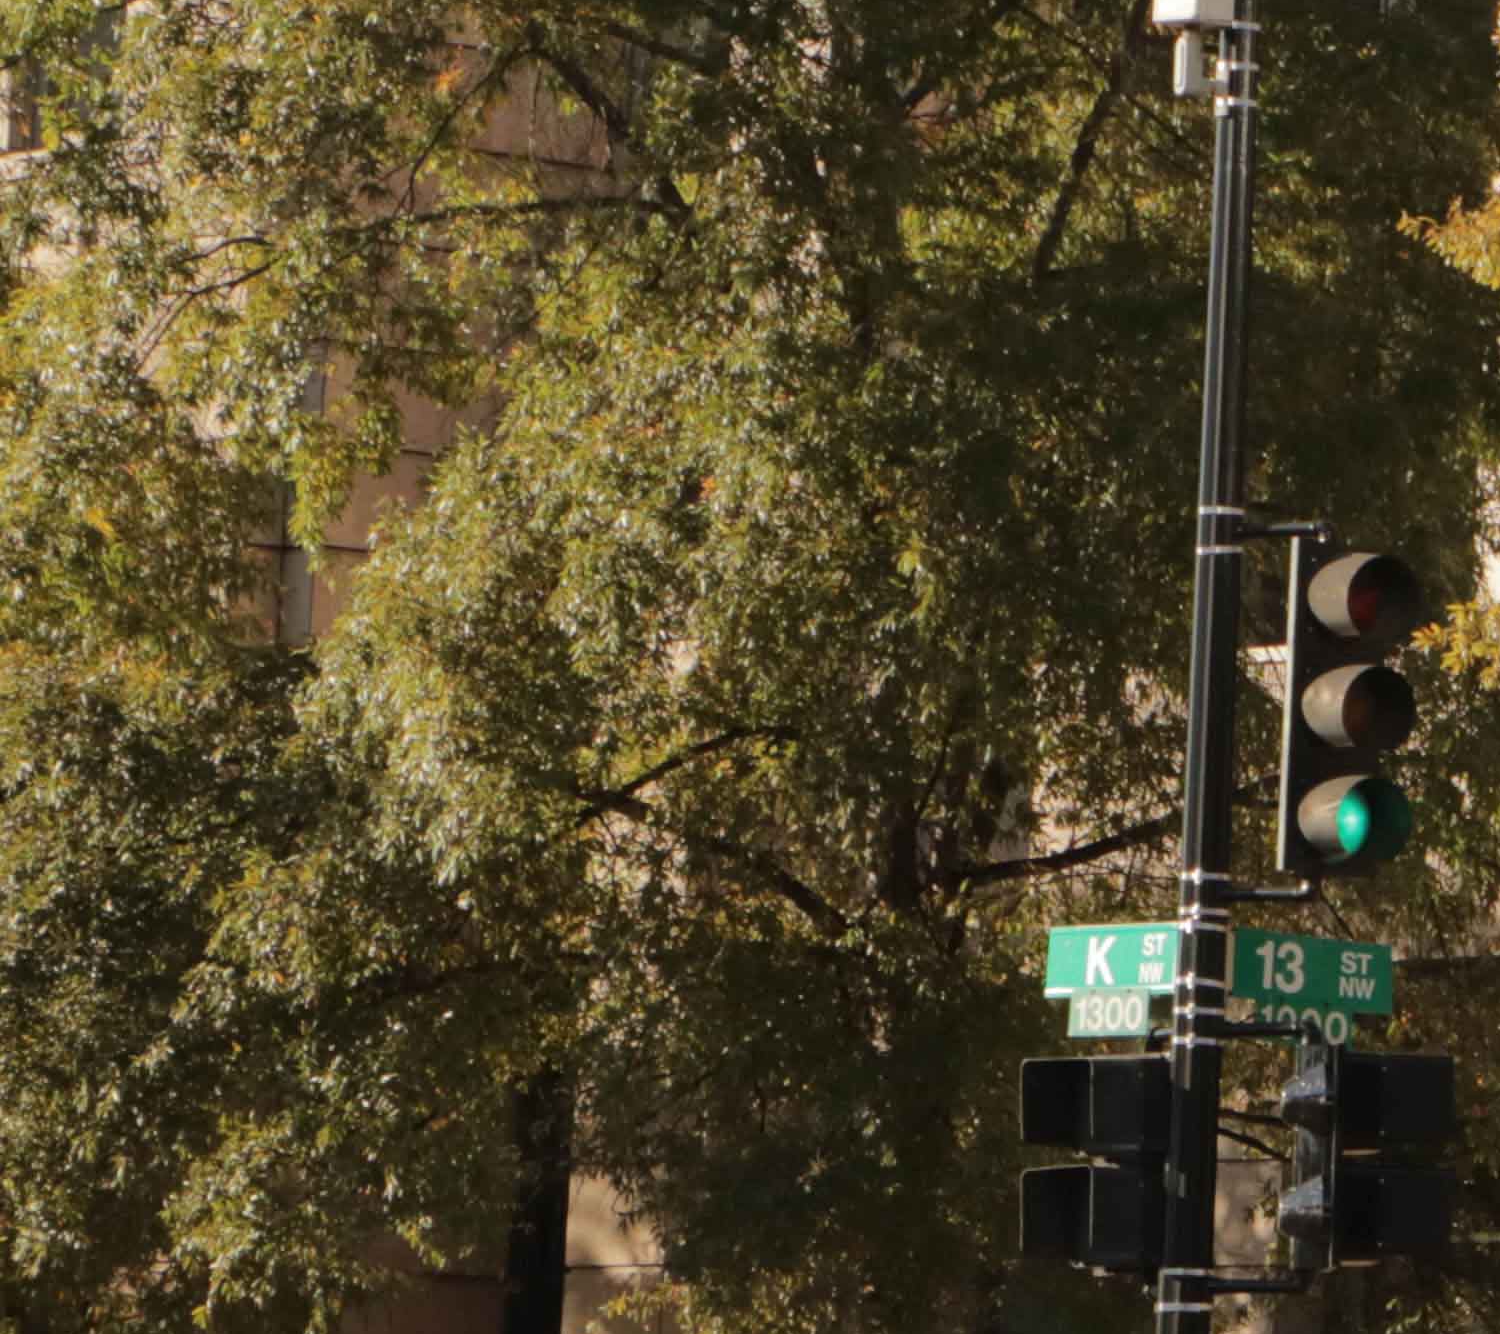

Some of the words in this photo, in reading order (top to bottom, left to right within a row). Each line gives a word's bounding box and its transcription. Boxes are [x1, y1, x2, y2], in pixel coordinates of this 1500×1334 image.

[1141, 933, 1167, 955] ST
[1085, 936, 1115, 986] K
[1256, 940, 1305, 995] 13
[1339, 951, 1373, 976] ST
[1138, 963, 1162, 985] NW
[1338, 976, 1376, 1001] NW
[1074, 996, 1142, 1031] 1300
